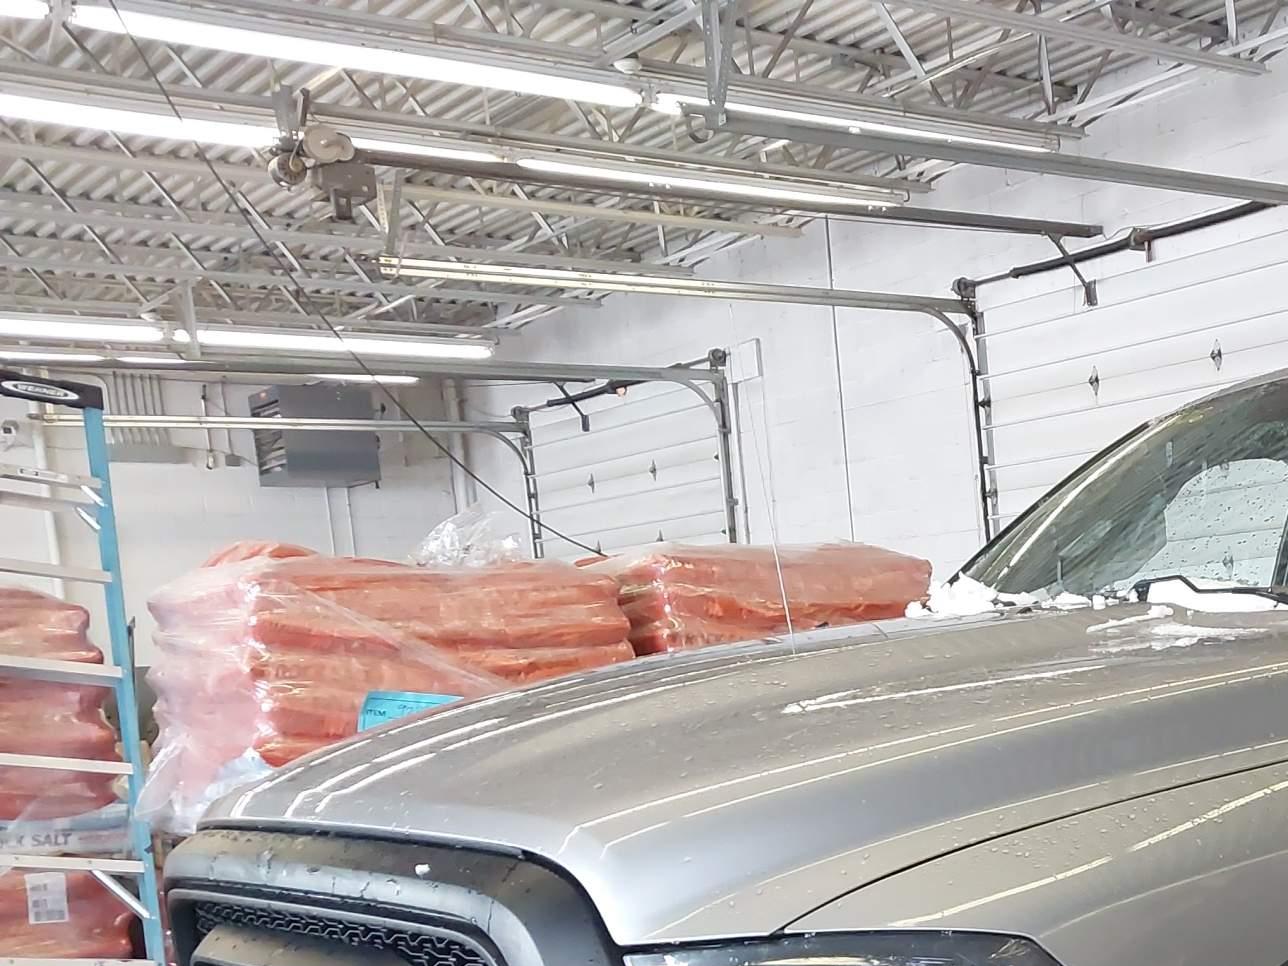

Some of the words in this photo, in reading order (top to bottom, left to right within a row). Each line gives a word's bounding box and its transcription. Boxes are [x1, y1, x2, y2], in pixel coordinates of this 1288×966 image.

[17, 384, 65, 397] WERNER
[366, 709, 386, 717] ITEM
[31, 832, 72, 847] SALT
